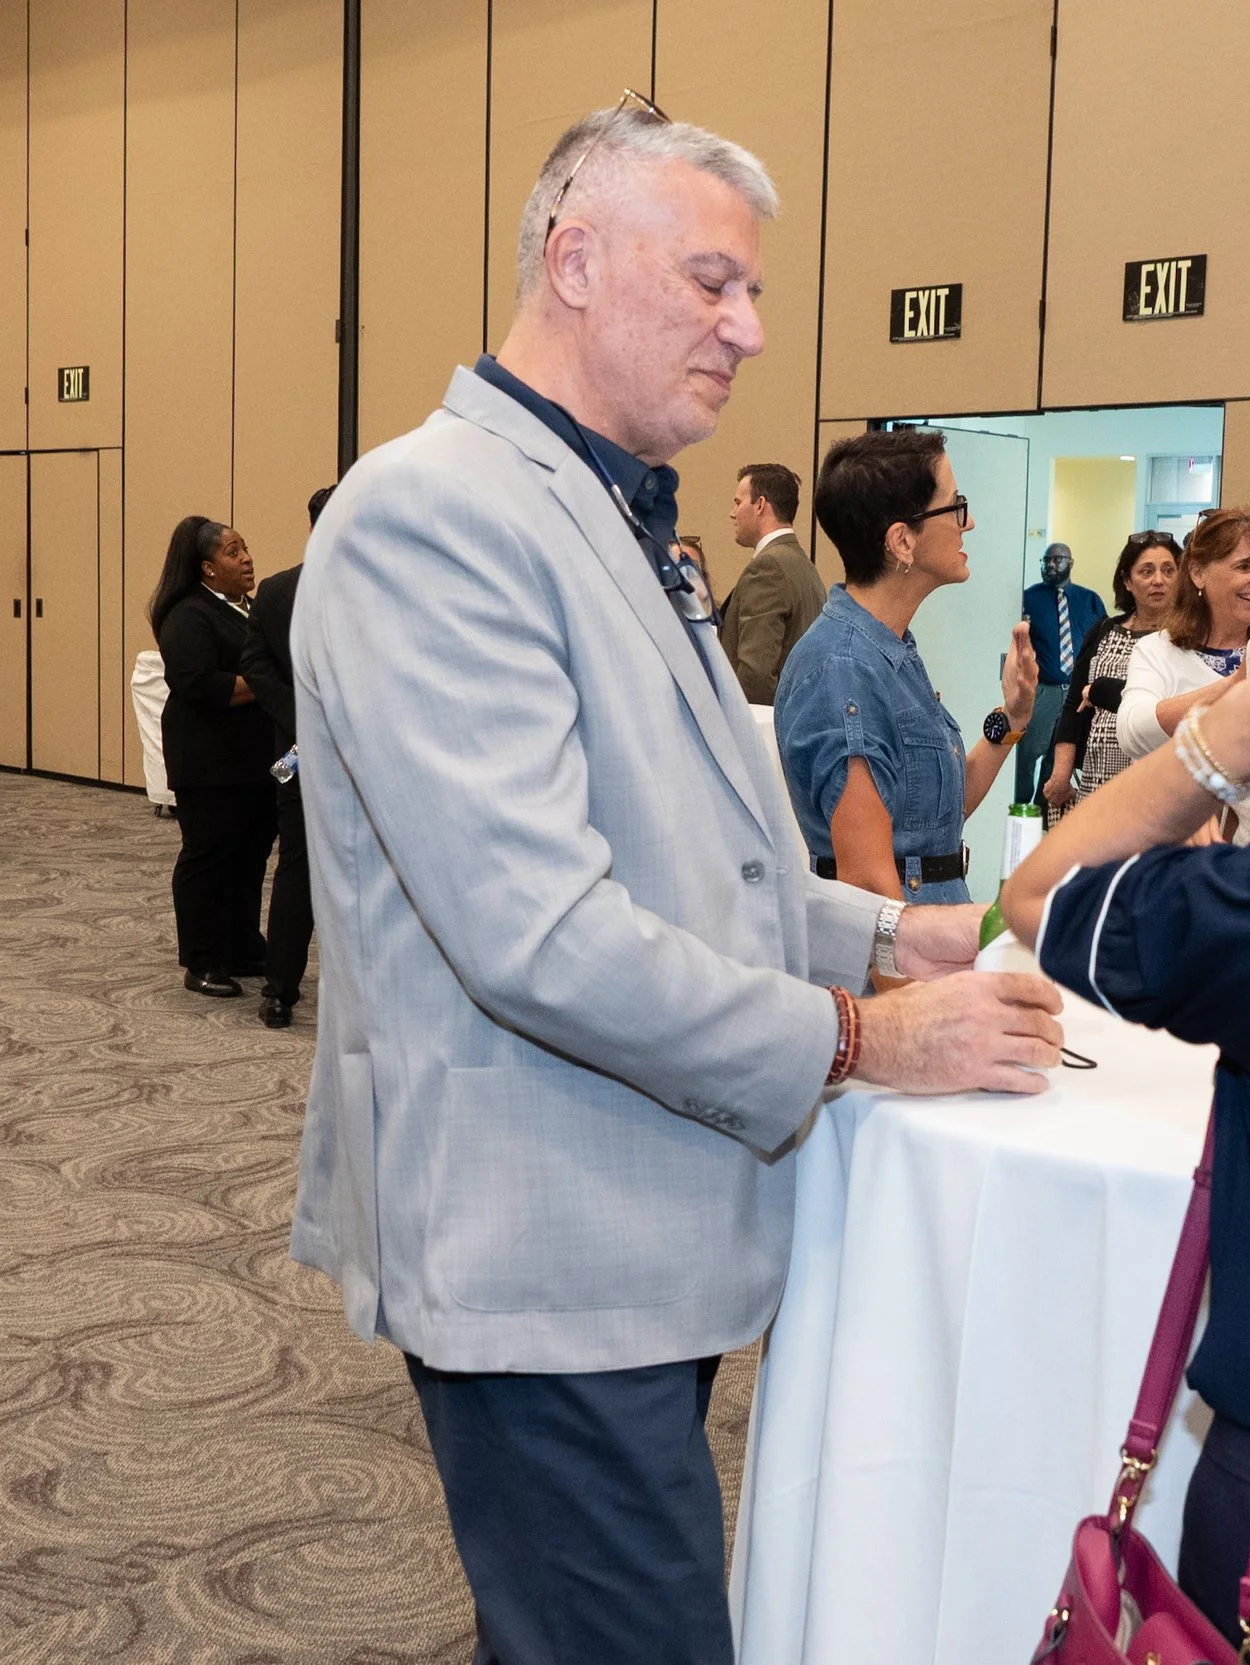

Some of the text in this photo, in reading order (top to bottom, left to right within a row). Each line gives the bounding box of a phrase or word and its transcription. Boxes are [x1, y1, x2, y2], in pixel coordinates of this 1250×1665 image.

[904, 288, 949, 338] EXIT
[1139, 260, 1191, 316] EXIT
[63, 368, 83, 399] EXIT
